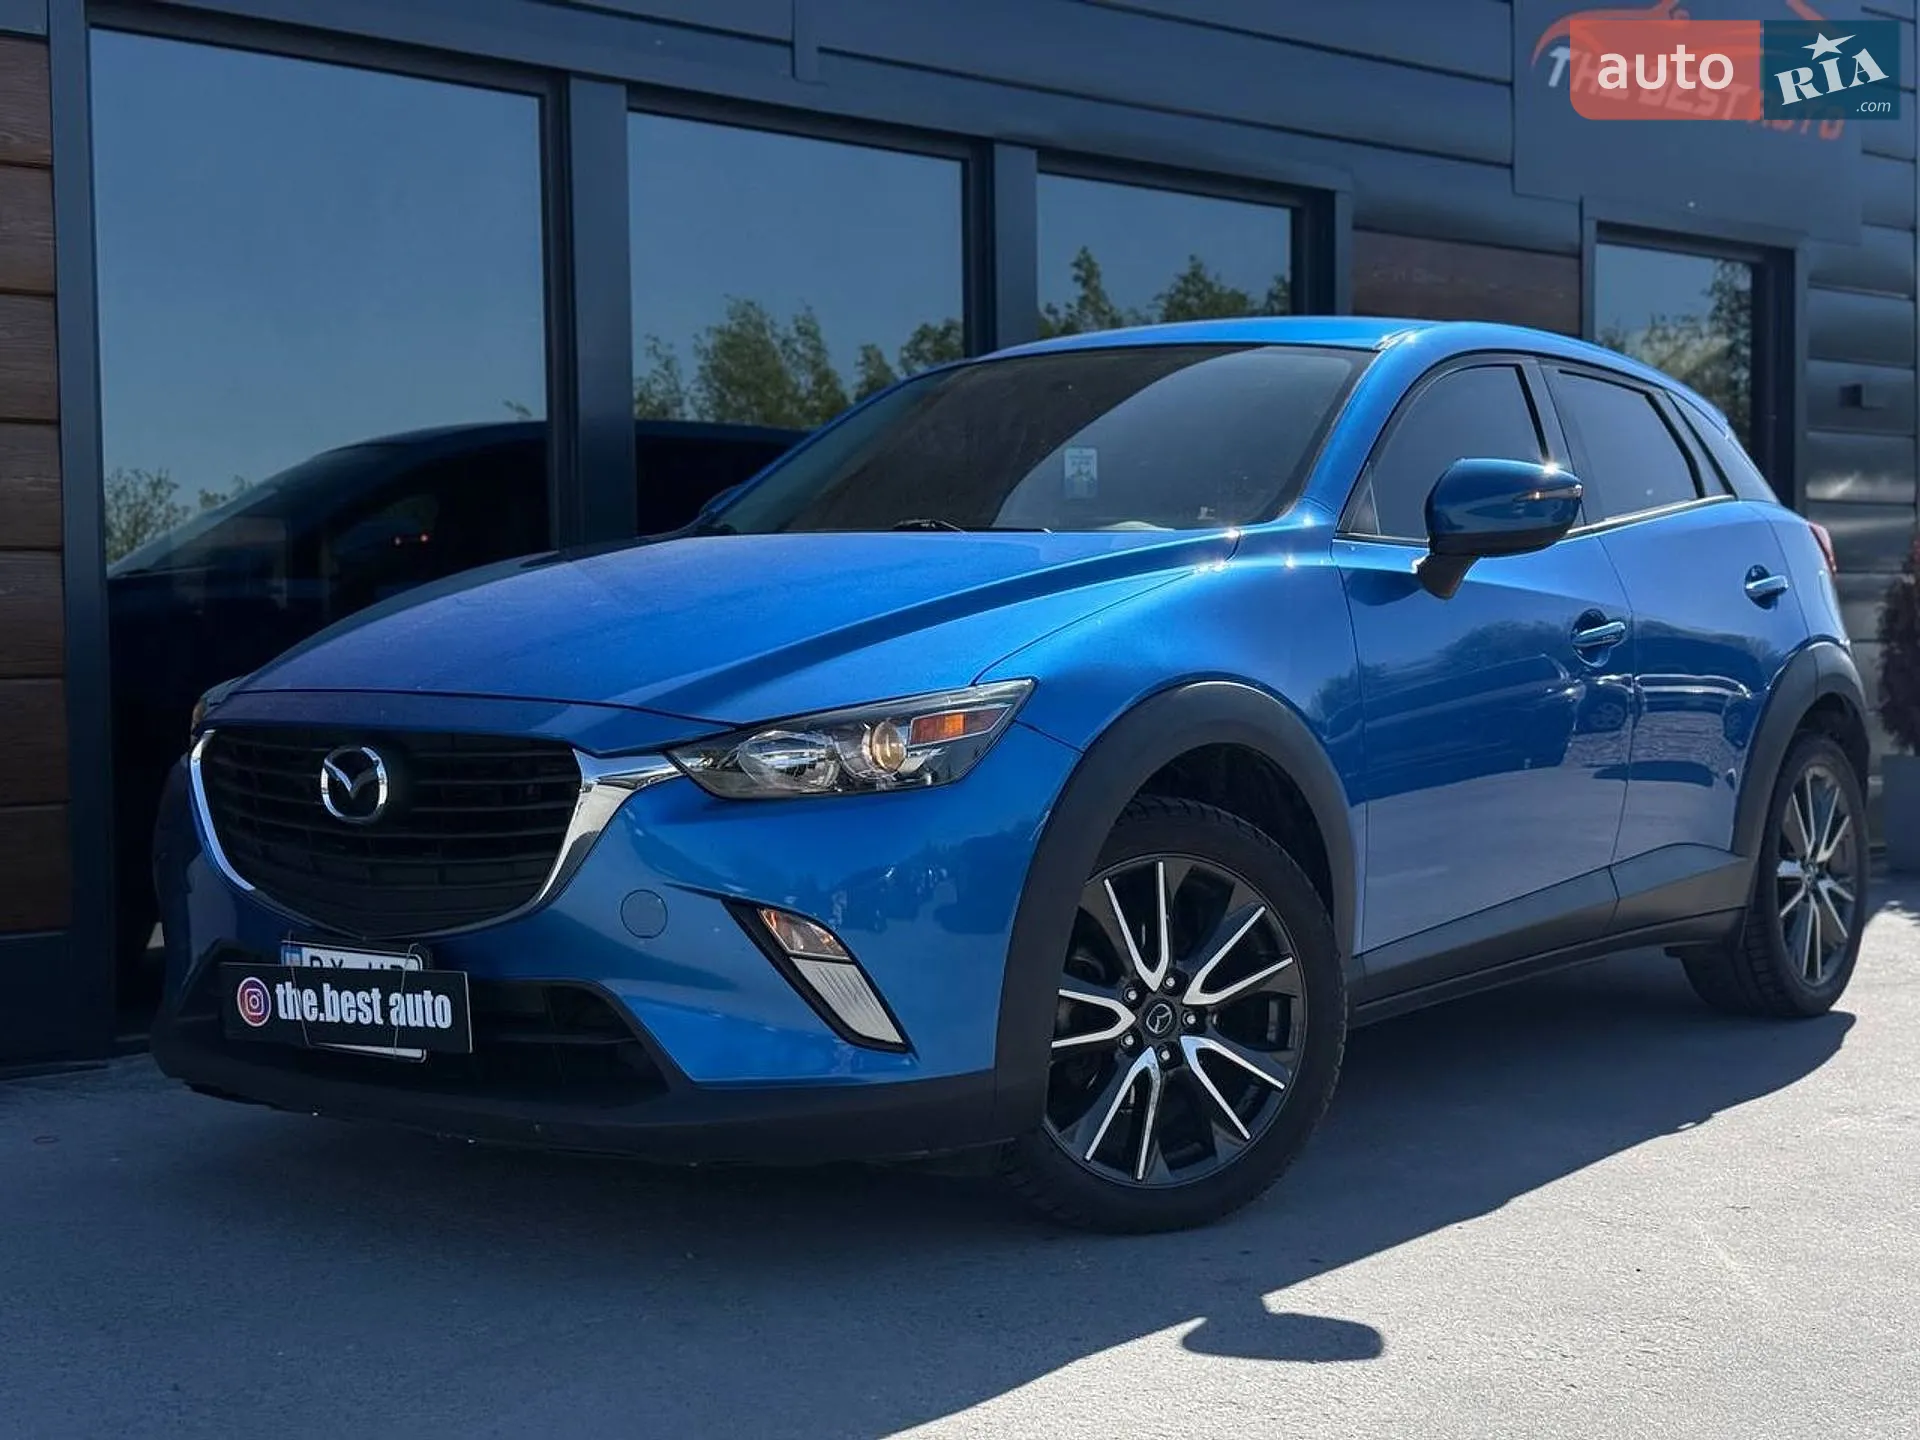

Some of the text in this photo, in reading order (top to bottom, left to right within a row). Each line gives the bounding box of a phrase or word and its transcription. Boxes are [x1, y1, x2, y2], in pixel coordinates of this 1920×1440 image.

[1637, 62, 1753, 120] BEST
[275, 981, 452, 1029] the.best auto
